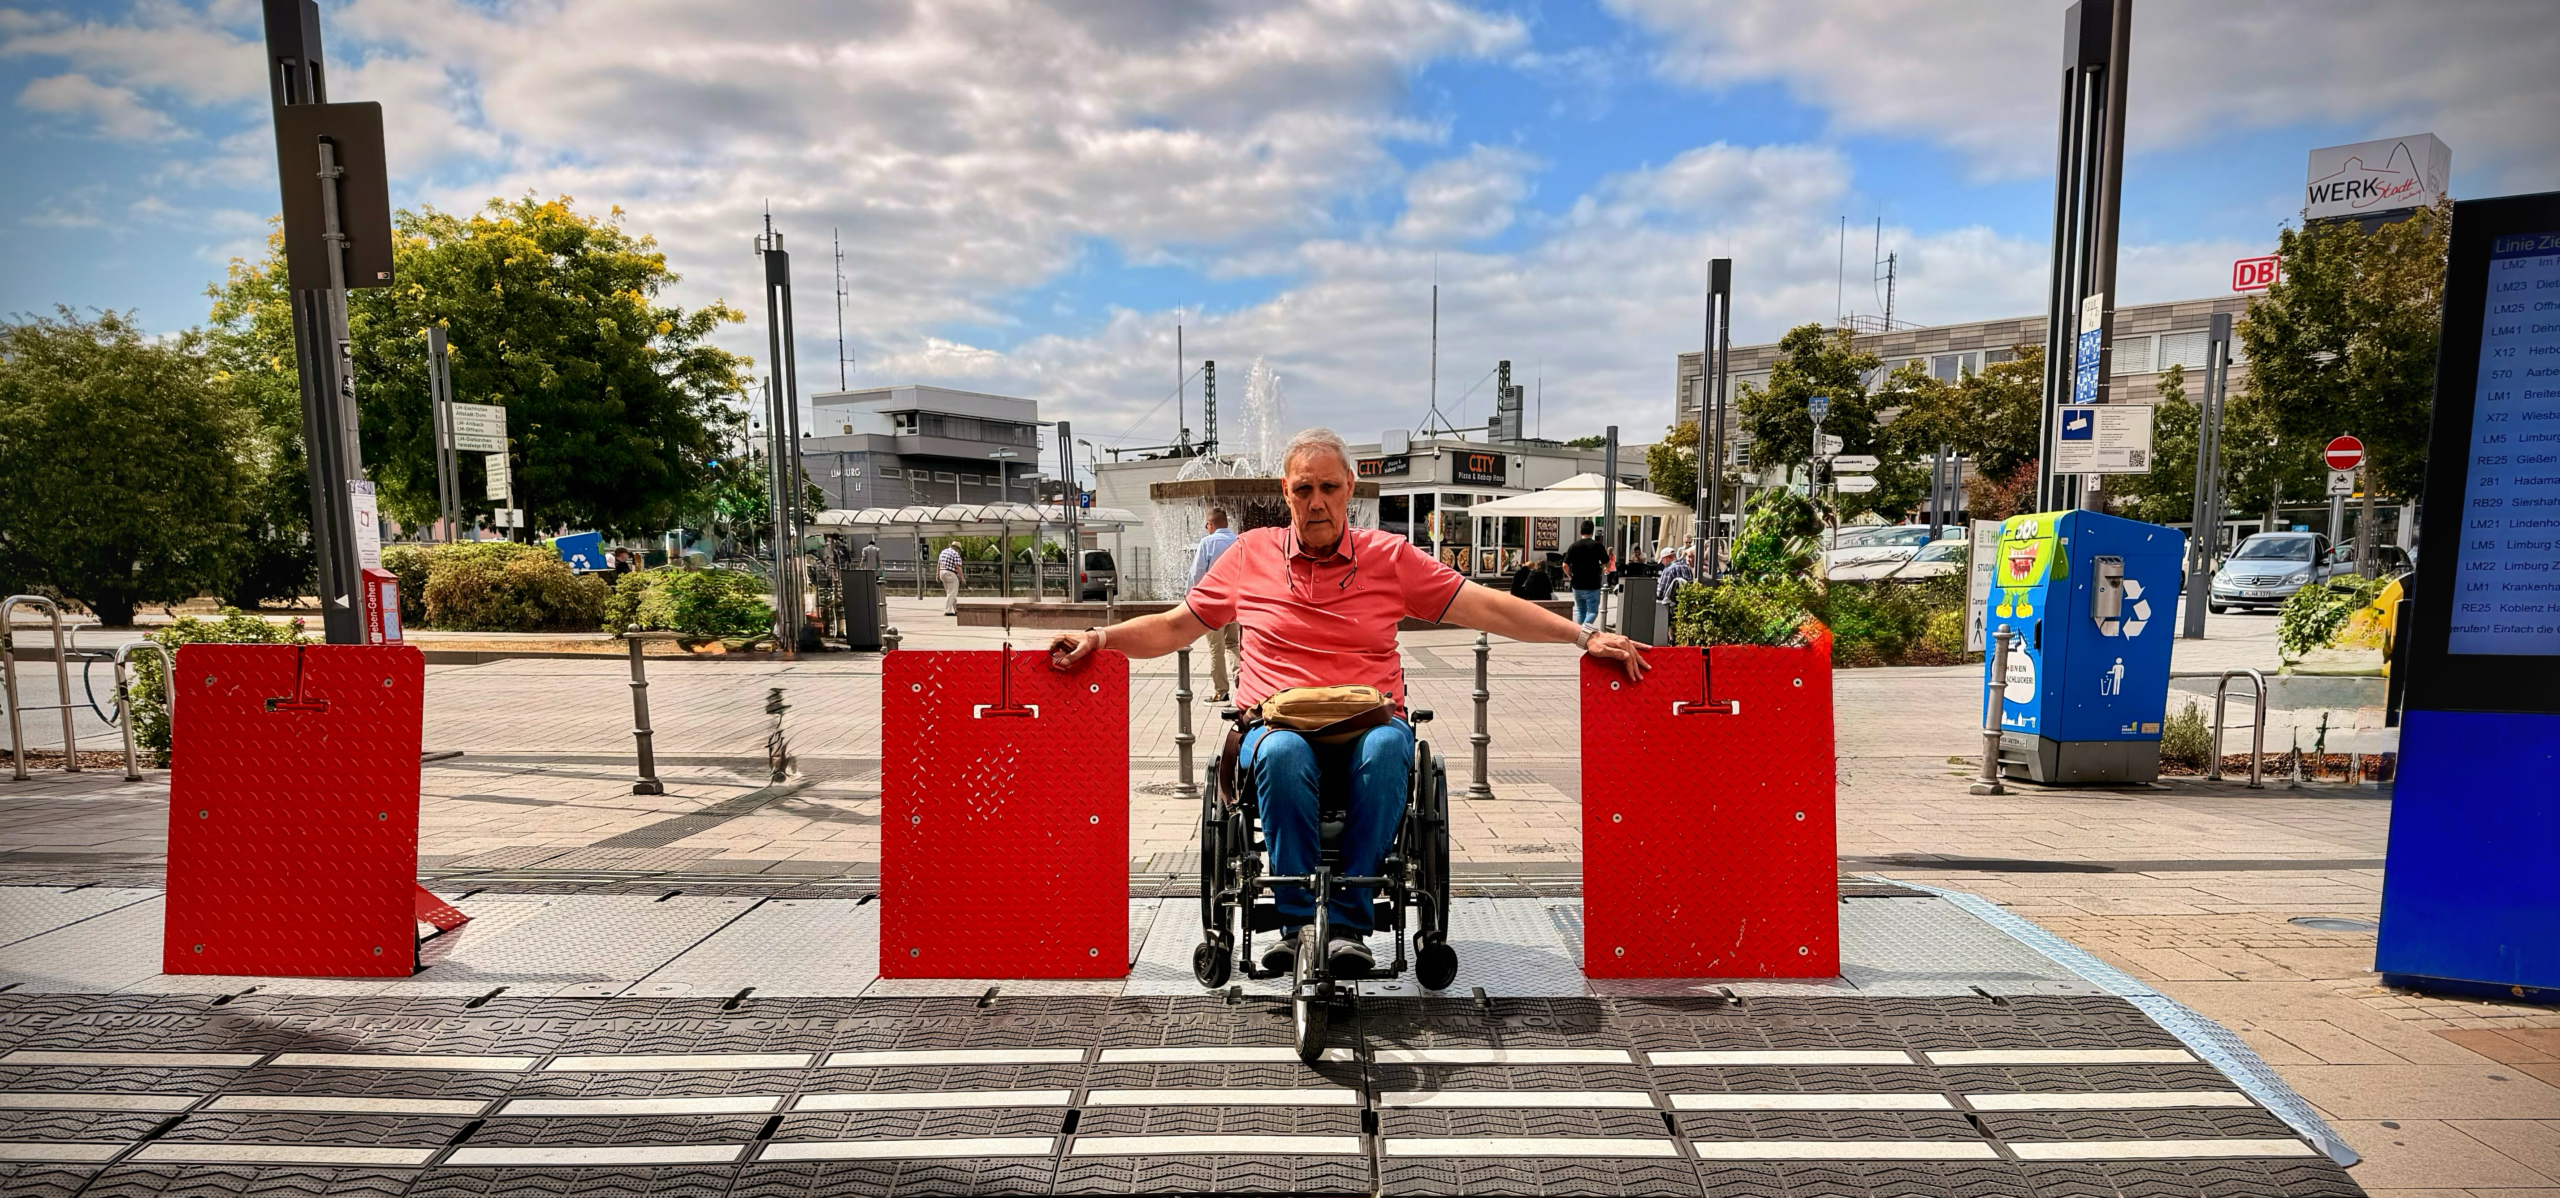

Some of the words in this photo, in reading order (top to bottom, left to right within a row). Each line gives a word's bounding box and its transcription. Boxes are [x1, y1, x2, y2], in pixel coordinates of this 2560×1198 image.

[2496, 237, 2535, 253] Linie
[2502, 260, 2527, 270] LM2
[2539, 258, 2553, 267] Im
[2239, 262, 2274, 286] DB
[2496, 281, 2528, 292] LM23
[2494, 303, 2525, 314] LM25
[2491, 326, 2522, 336] LM41
[2493, 347, 2516, 358] X12
[2491, 369, 2513, 379] 570
[2487, 391, 2511, 401] LM1
[2486, 412, 2508, 422] X72
[2483, 434, 2507, 444] LM5
[1469, 454, 1495, 473] CITY
[2477, 455, 2508, 465] RE25
[2516, 454, 2557, 464] Gießen
[831, 468, 861, 477] LIMURG
[1359, 460, 1384, 475] CITY
[1458, 472, 1471, 480] Pizza
[2480, 477, 2499, 486] 281
[1082, 495, 1089, 507] P
[2473, 498, 2504, 508] RB29
[2470, 519, 2500, 529] LM21
[2471, 540, 2495, 550] LM5
[2507, 540, 2551, 550] Limburg
[2465, 562, 2496, 571] LM22
[2504, 562, 2549, 572] Limburg
[2466, 583, 2489, 591] LM1
[367, 581, 380, 633] eben-Gehen
[1972, 598, 1987, 606] Campu
[2461, 603, 2491, 612] RE25
[2500, 603, 2544, 613] Koblenz
[2493, 624, 2534, 634] Einfach
[2536, 625, 2554, 634] die
[2007, 676, 2034, 684] SCHLUCKER!
[0, 1013, 60, 1028] NE
[63, 1013, 211, 1029] ARMIS
[221, 1016, 317, 1031] ONE
[323, 1016, 470, 1031] ARMIS
[483, 1019, 577, 1033] ONE
[586, 1019, 731, 1033] ARMIS
[746, 1019, 839, 1032] ONE
[1005, 1015, 1096, 1028] ONE
